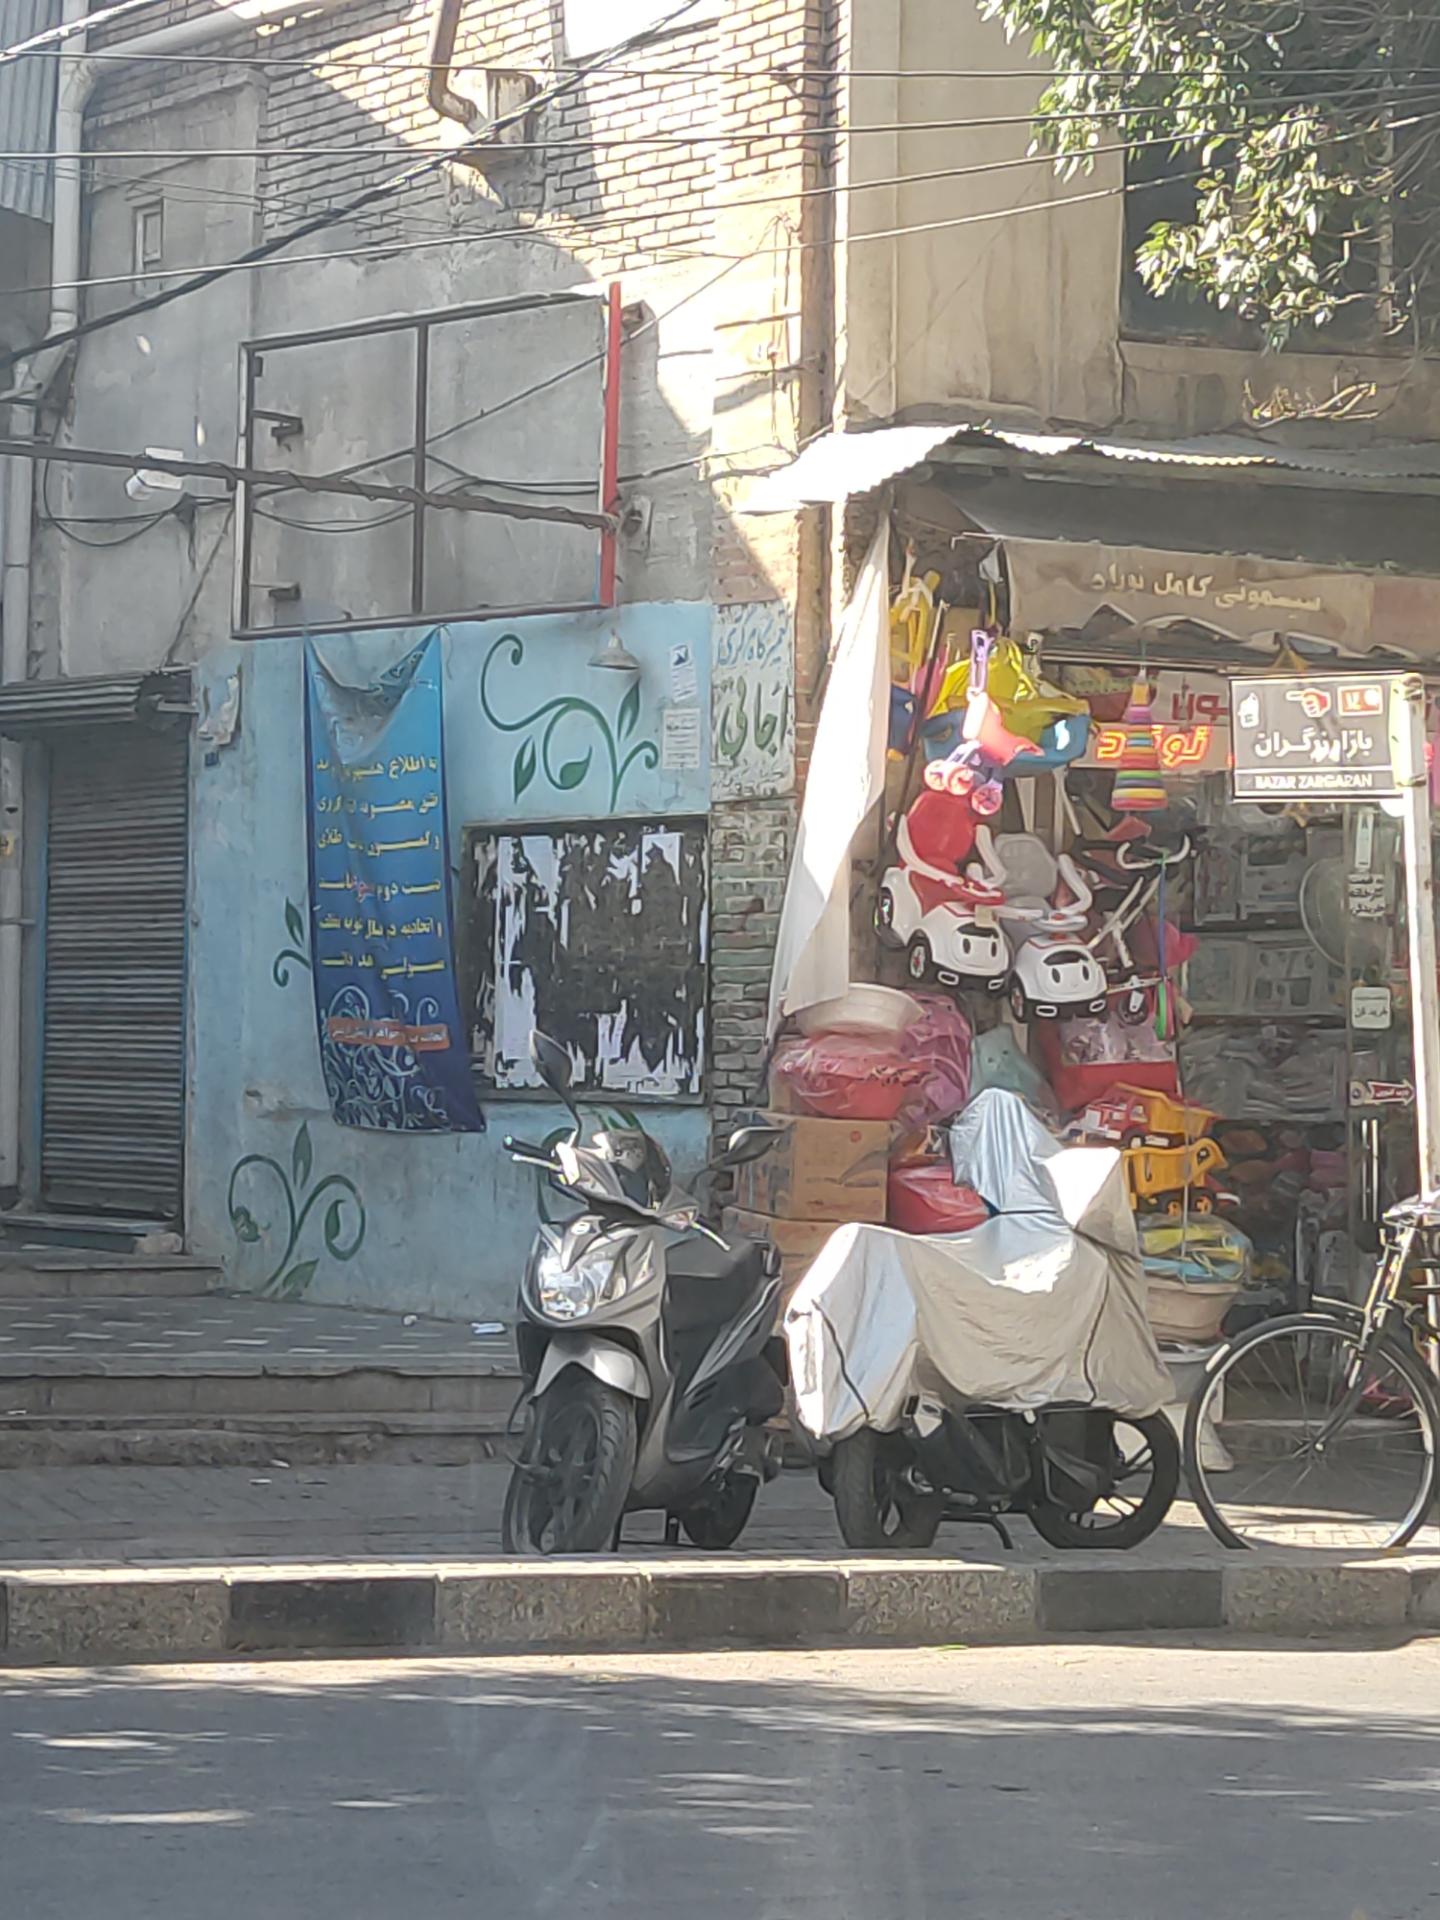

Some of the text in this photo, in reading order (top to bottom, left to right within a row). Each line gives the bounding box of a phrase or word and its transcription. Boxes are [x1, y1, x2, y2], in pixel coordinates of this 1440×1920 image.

[1153, 571, 1214, 599] کامل
[1254, 726, 1373, 763] بازار زرگران
[389, 755, 426, 779] اطلاع
[1255, 773, 1372, 789] BAZAR ZARGARAN
